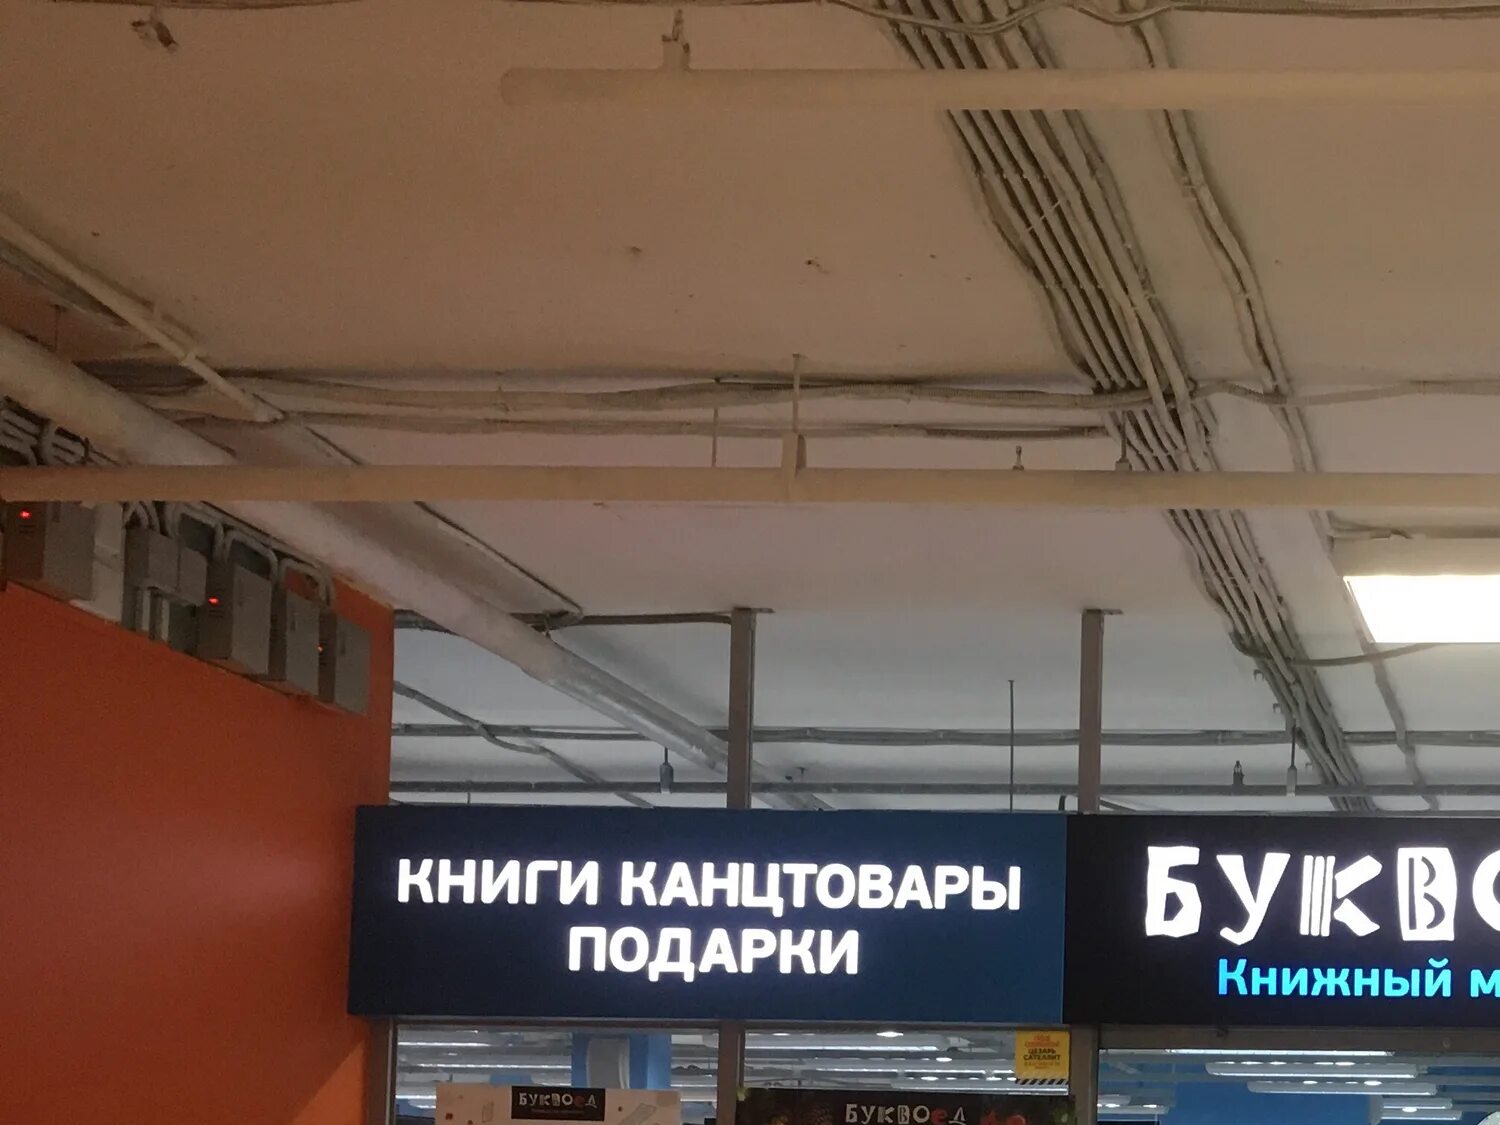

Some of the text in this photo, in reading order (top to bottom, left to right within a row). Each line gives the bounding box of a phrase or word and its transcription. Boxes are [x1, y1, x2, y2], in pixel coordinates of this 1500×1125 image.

[397, 857, 1022, 918] КНИГИ КАНЦТОВАРЫ
[567, 925, 861, 983] ПОДАРКИ
[1217, 957, 1452, 998] Книжный
